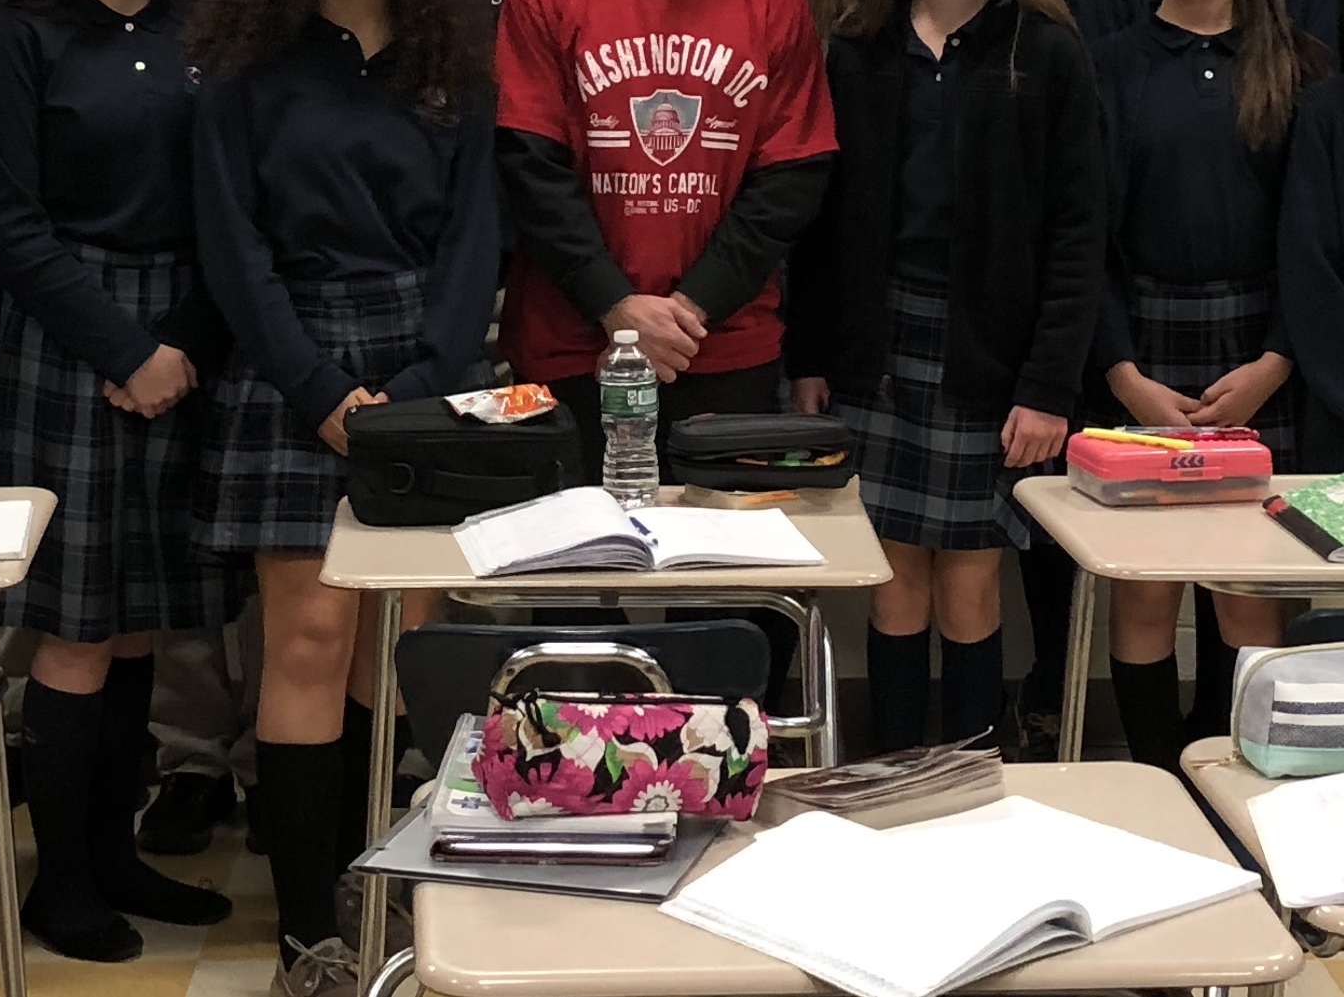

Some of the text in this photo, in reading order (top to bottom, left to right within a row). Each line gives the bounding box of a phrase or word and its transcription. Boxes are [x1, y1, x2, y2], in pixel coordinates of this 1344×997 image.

[574, 33, 769, 109] WASHINGTON DC
[592, 172, 662, 195] NATION'S
[663, 198, 702, 214] US-DC
